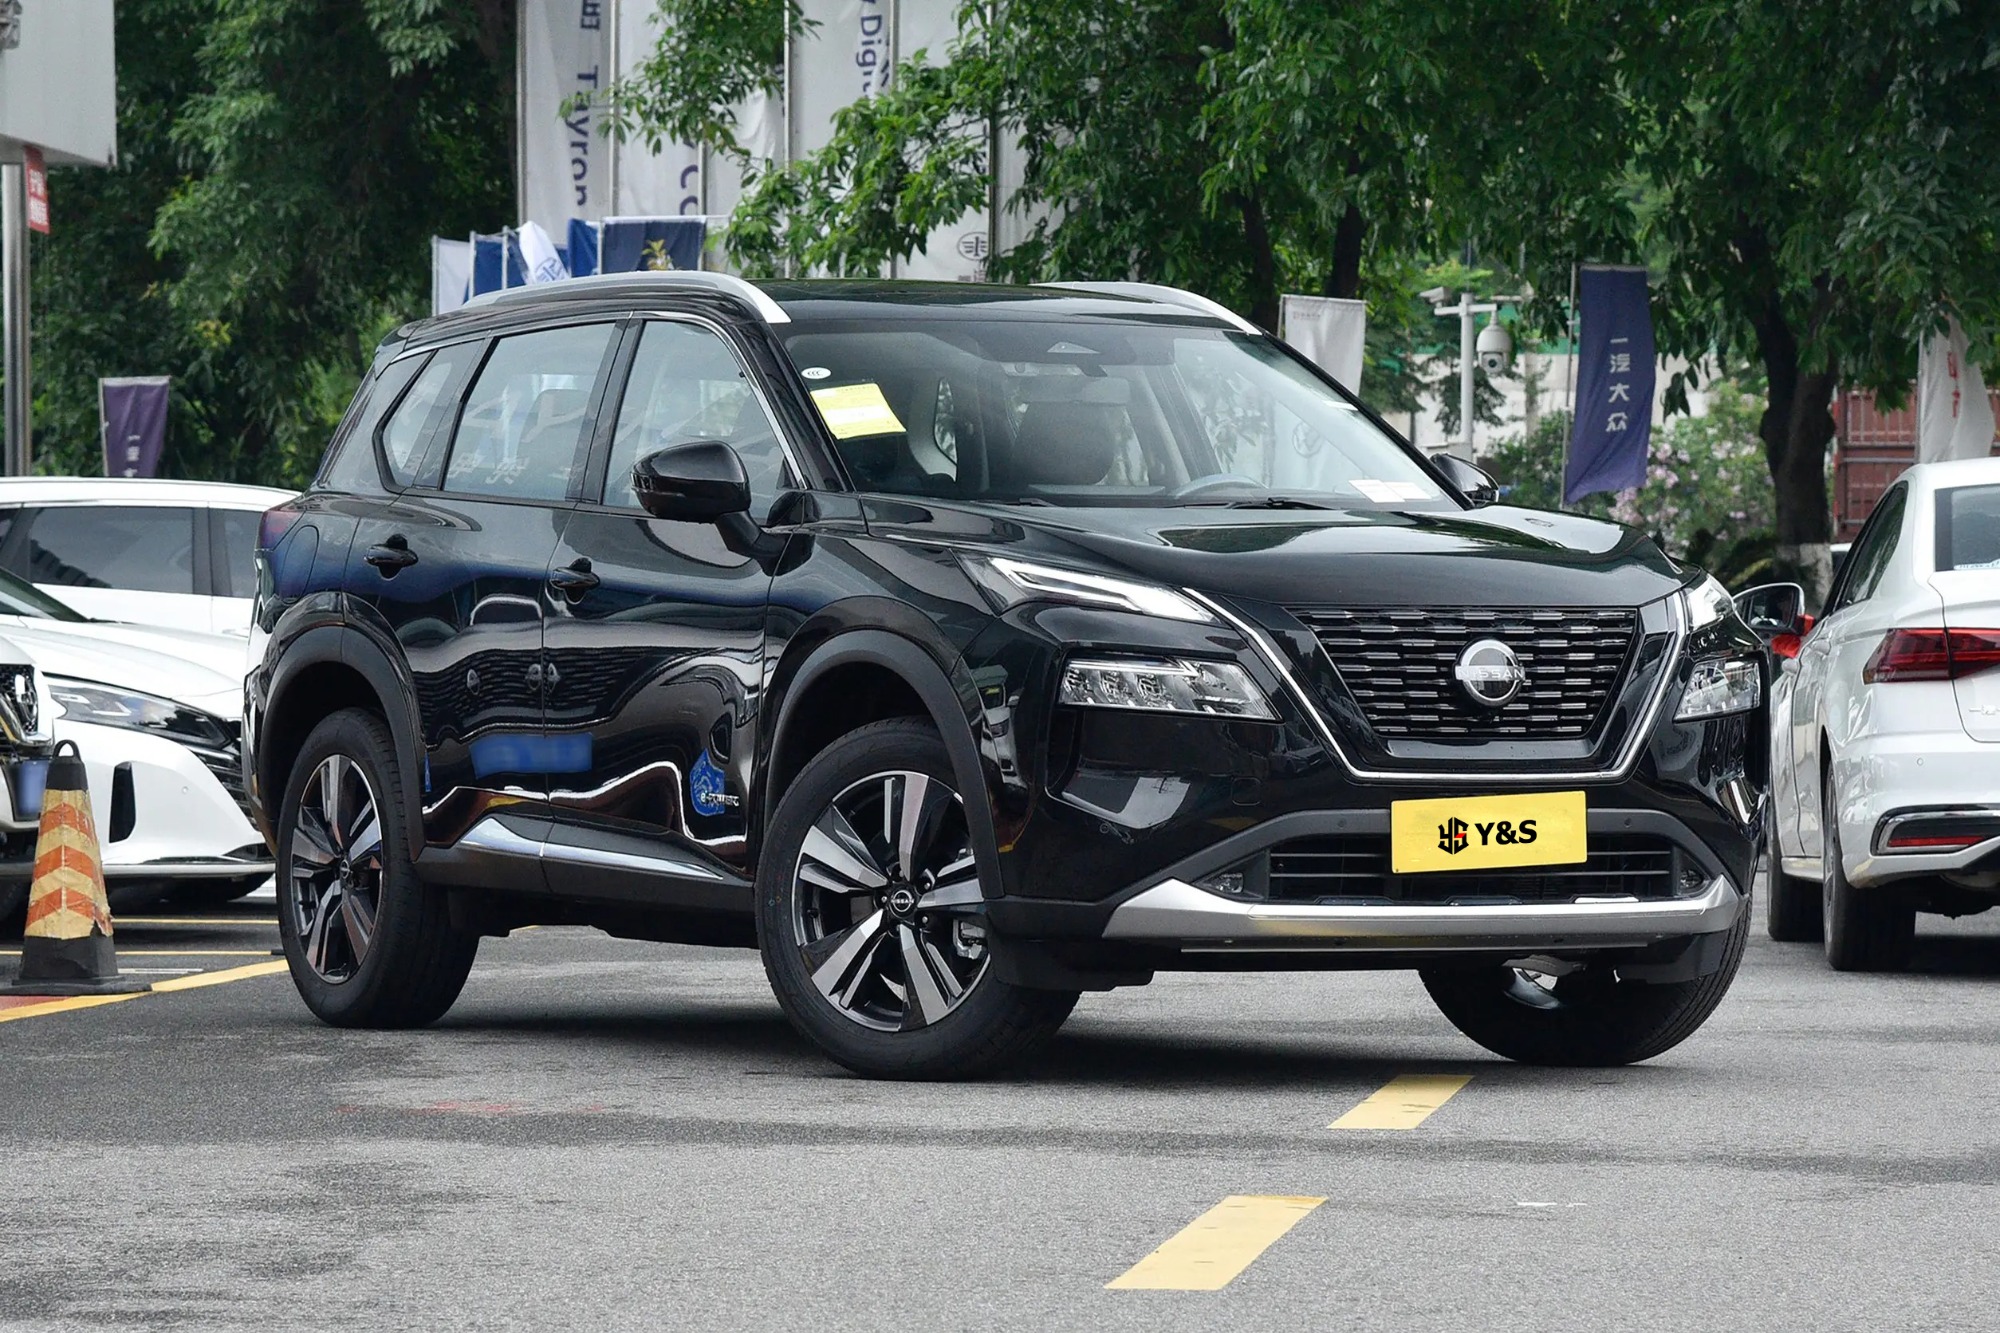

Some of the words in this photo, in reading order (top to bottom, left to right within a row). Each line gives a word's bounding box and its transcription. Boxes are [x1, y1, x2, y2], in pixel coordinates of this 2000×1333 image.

[1606, 337, 1631, 432] 一汽大众
[1458, 668, 1523, 679] NISSAN
